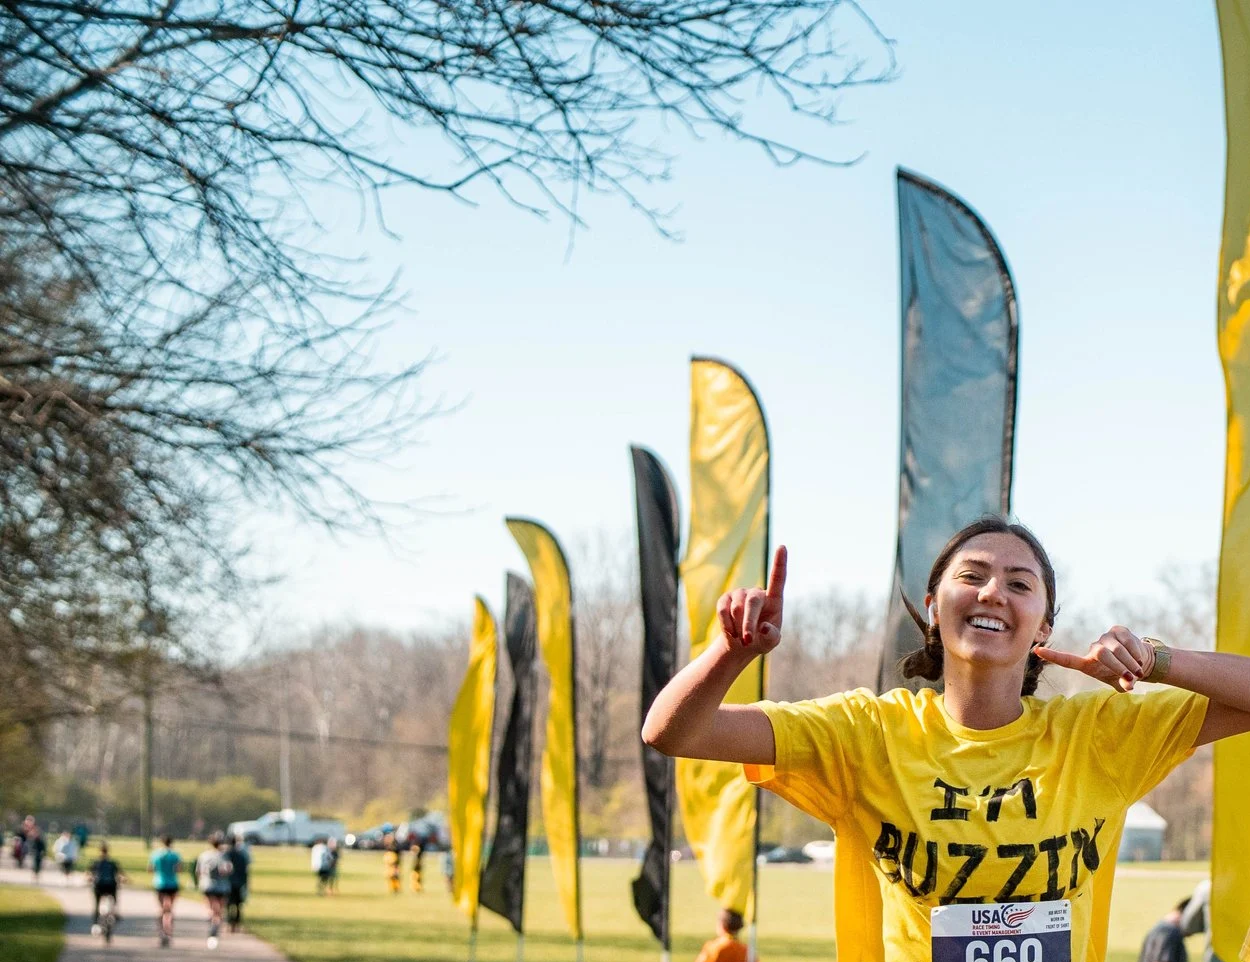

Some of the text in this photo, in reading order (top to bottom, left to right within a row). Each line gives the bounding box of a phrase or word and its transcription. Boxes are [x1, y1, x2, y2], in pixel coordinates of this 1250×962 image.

[930, 777, 1037, 822] I'M
[872, 817, 1106, 904] BUZZIN
[972, 909, 1000, 924] USA
